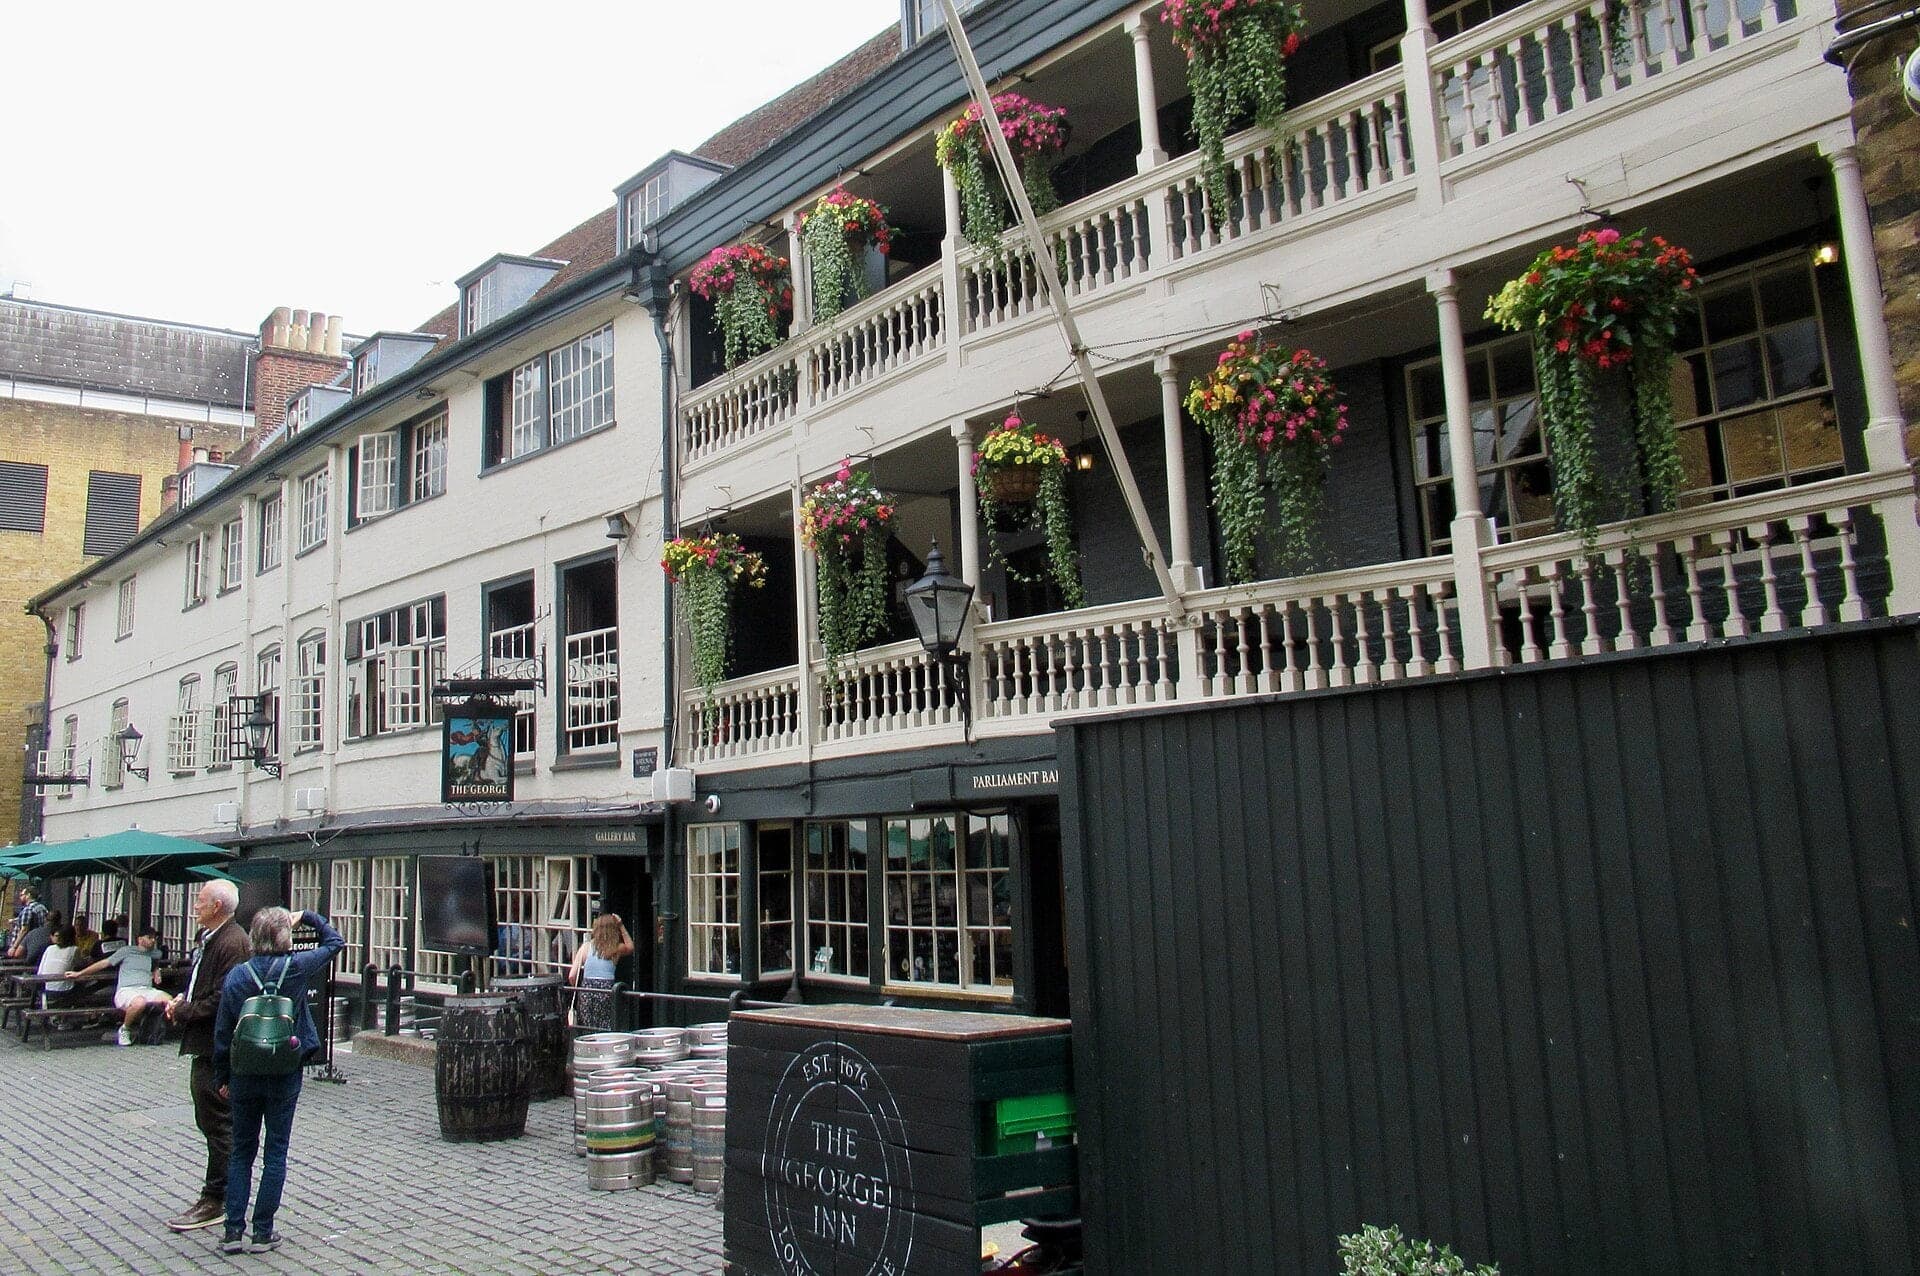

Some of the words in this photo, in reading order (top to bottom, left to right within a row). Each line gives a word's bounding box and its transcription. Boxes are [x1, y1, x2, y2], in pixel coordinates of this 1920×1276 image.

[451, 784, 468, 795] THE
[470, 784, 508, 795] GEORGE
[973, 771, 1038, 788] PARLIAMENT
[595, 831, 622, 842] GALLERY
[623, 831, 637, 842] BAR
[802, 1053, 832, 1082] EST.
[840, 1055, 869, 1091] 1676
[811, 1120, 858, 1160] THE
[785, 1157, 886, 1209] GEORGE
[814, 1205, 857, 1248] INN
